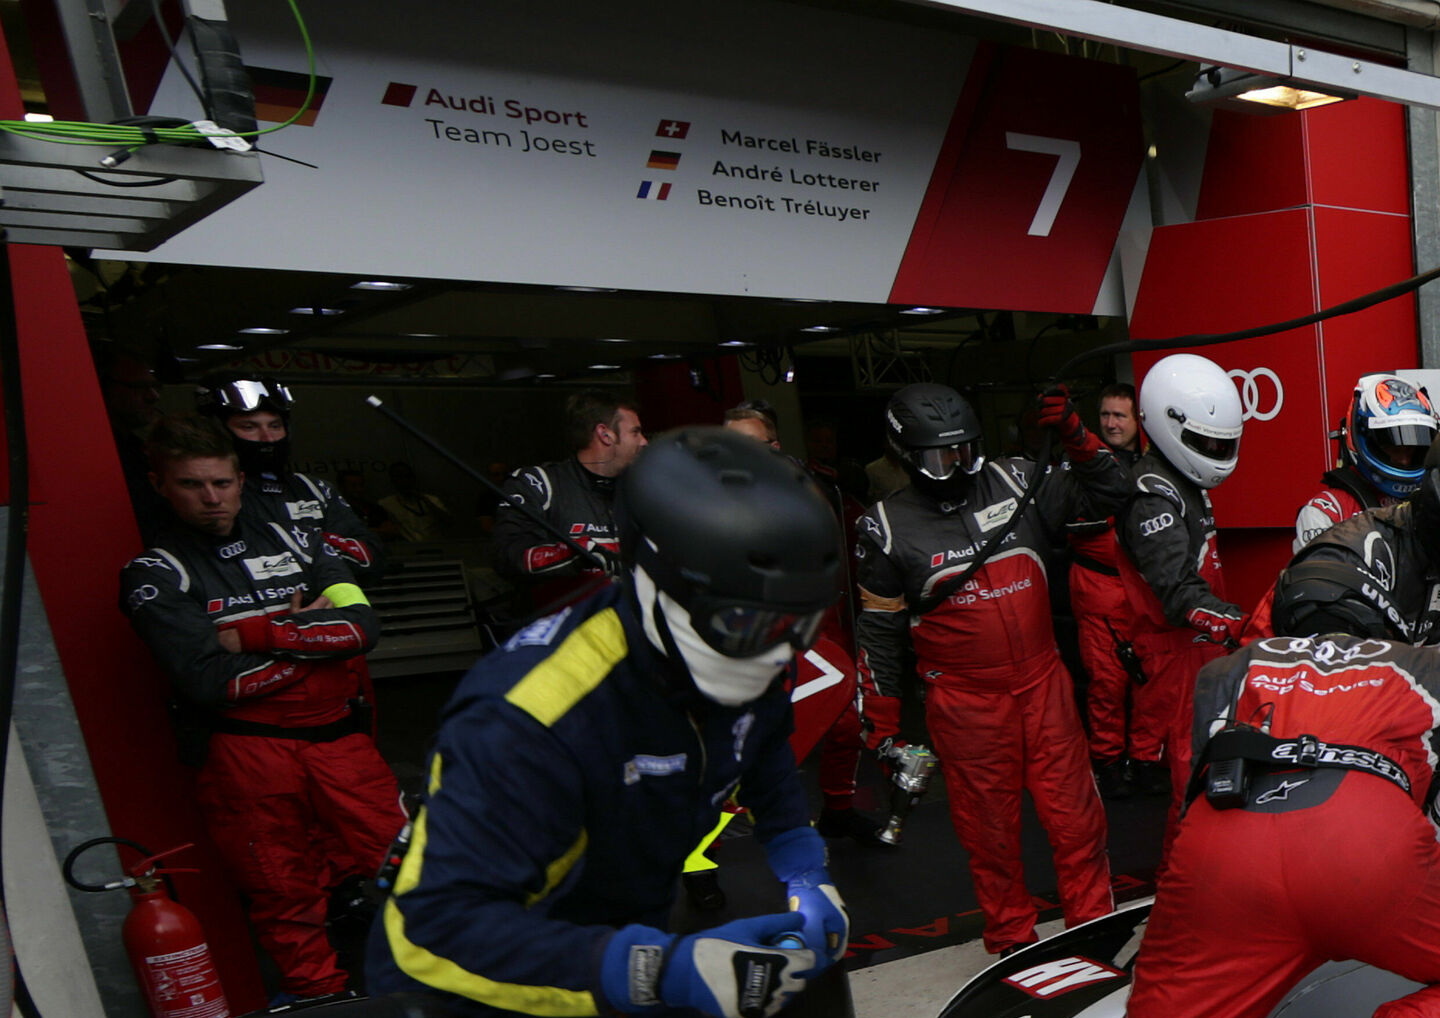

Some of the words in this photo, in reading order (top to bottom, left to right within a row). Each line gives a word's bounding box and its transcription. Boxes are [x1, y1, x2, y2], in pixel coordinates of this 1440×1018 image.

[424, 88, 496, 115] Audi
[504, 99, 589, 128] Sport
[425, 118, 512, 147] Team
[520, 129, 597, 157] Joest
[720, 129, 800, 153] Marcel
[806, 139, 882, 163] Fässler
[711, 160, 783, 183] André
[789, 169, 880, 192] Lotterer
[1005, 131, 1082, 237] 7
[697, 189, 776, 212] Benoît
[781, 197, 871, 222] Tréluyer
[979, 578, 1033, 601] Service
[1361, 583, 1411, 638] uvex
[1251, 680, 1295, 696] Top
[1299, 679, 1385, 696] Service
[1252, 670, 1308, 685] Audi
